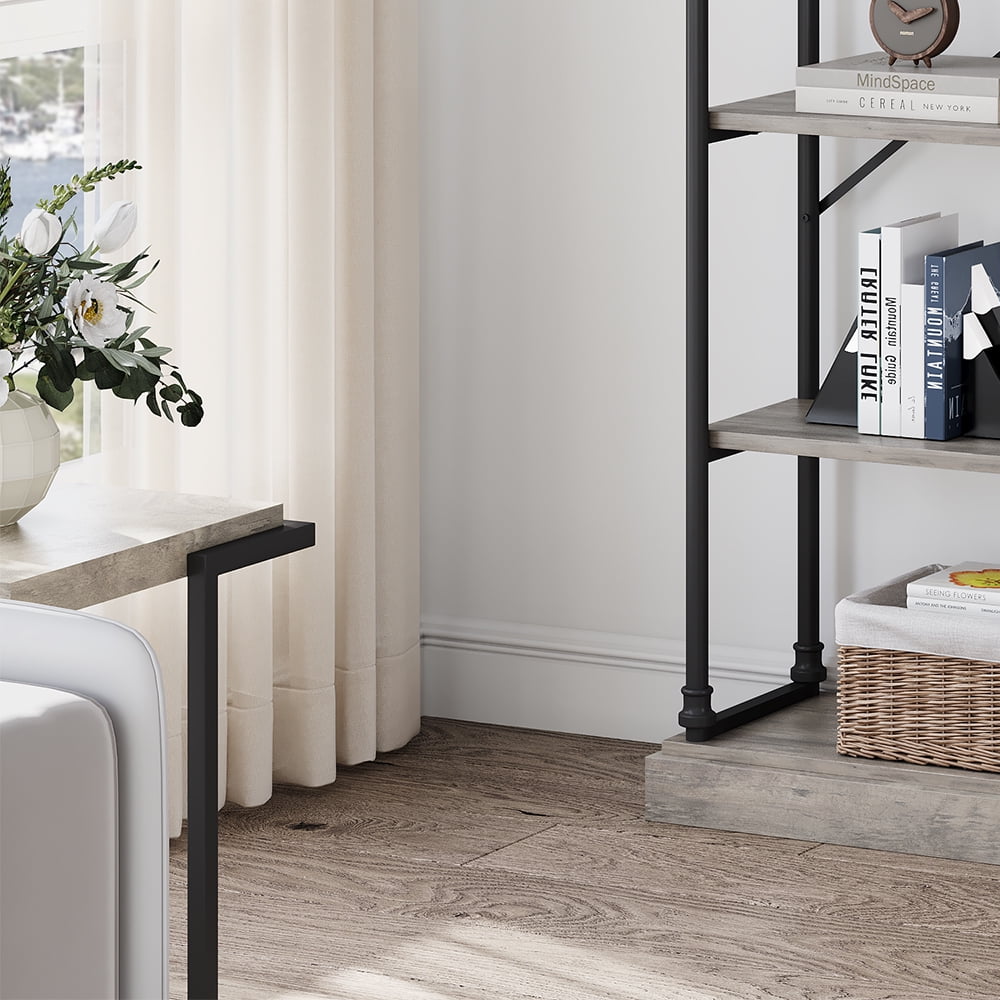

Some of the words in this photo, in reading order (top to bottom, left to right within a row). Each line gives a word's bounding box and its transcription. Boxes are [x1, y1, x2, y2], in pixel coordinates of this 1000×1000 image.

[856, 73, 936, 92] MindSpace
[859, 96, 915, 111] CEREAL
[923, 103, 944, 111] NEW
[947, 104, 972, 113] YORK
[925, 588, 951, 598] SEEING
[953, 591, 986, 601] FLOWERS
